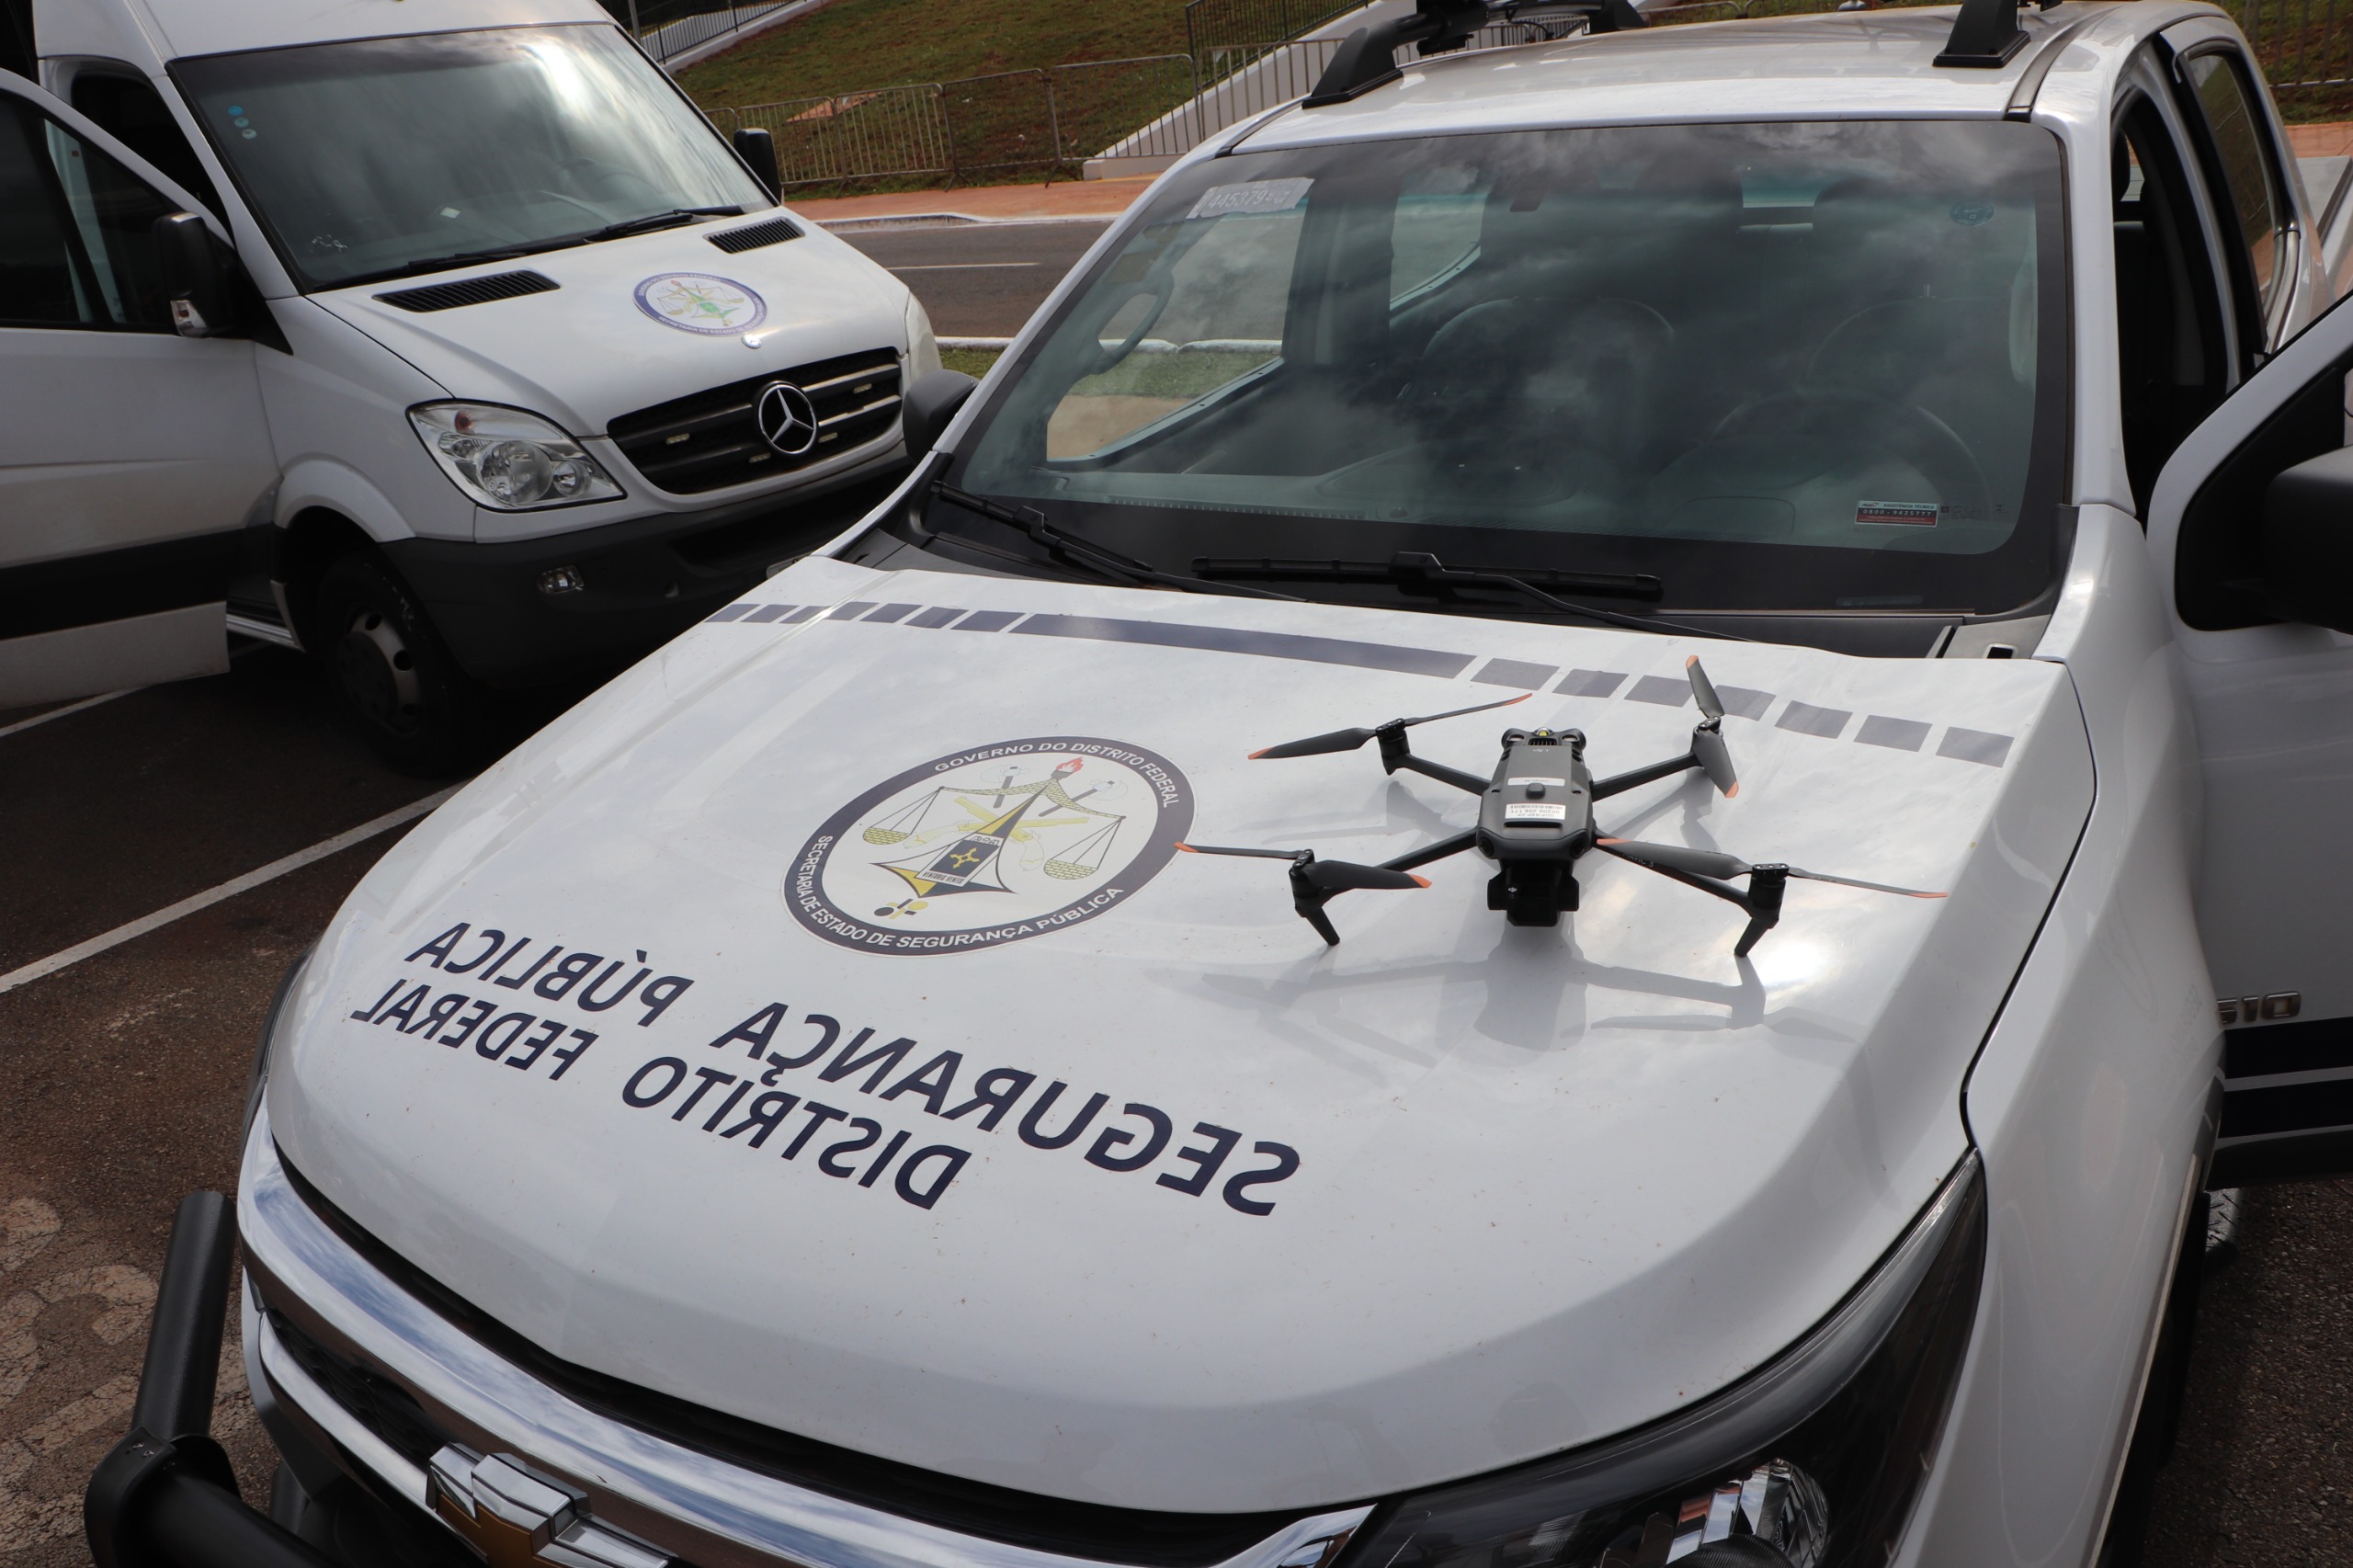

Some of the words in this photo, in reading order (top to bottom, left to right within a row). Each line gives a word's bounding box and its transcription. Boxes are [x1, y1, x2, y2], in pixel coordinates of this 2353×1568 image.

[935, 743, 1034, 772] GOVERNO
[1039, 742, 1067, 751] DO
[1070, 742, 1144, 765] DISTRITO
[1141, 762, 1180, 808] FEDERAL
[796, 835, 834, 899] SECRETARIA
[800, 895, 822, 913] DE
[1035, 886, 1124, 929] PÚBLICA
[810, 908, 869, 939] ESTADO
[866, 932, 897, 946] DE
[896, 925, 1034, 949] SEGURANÇA
